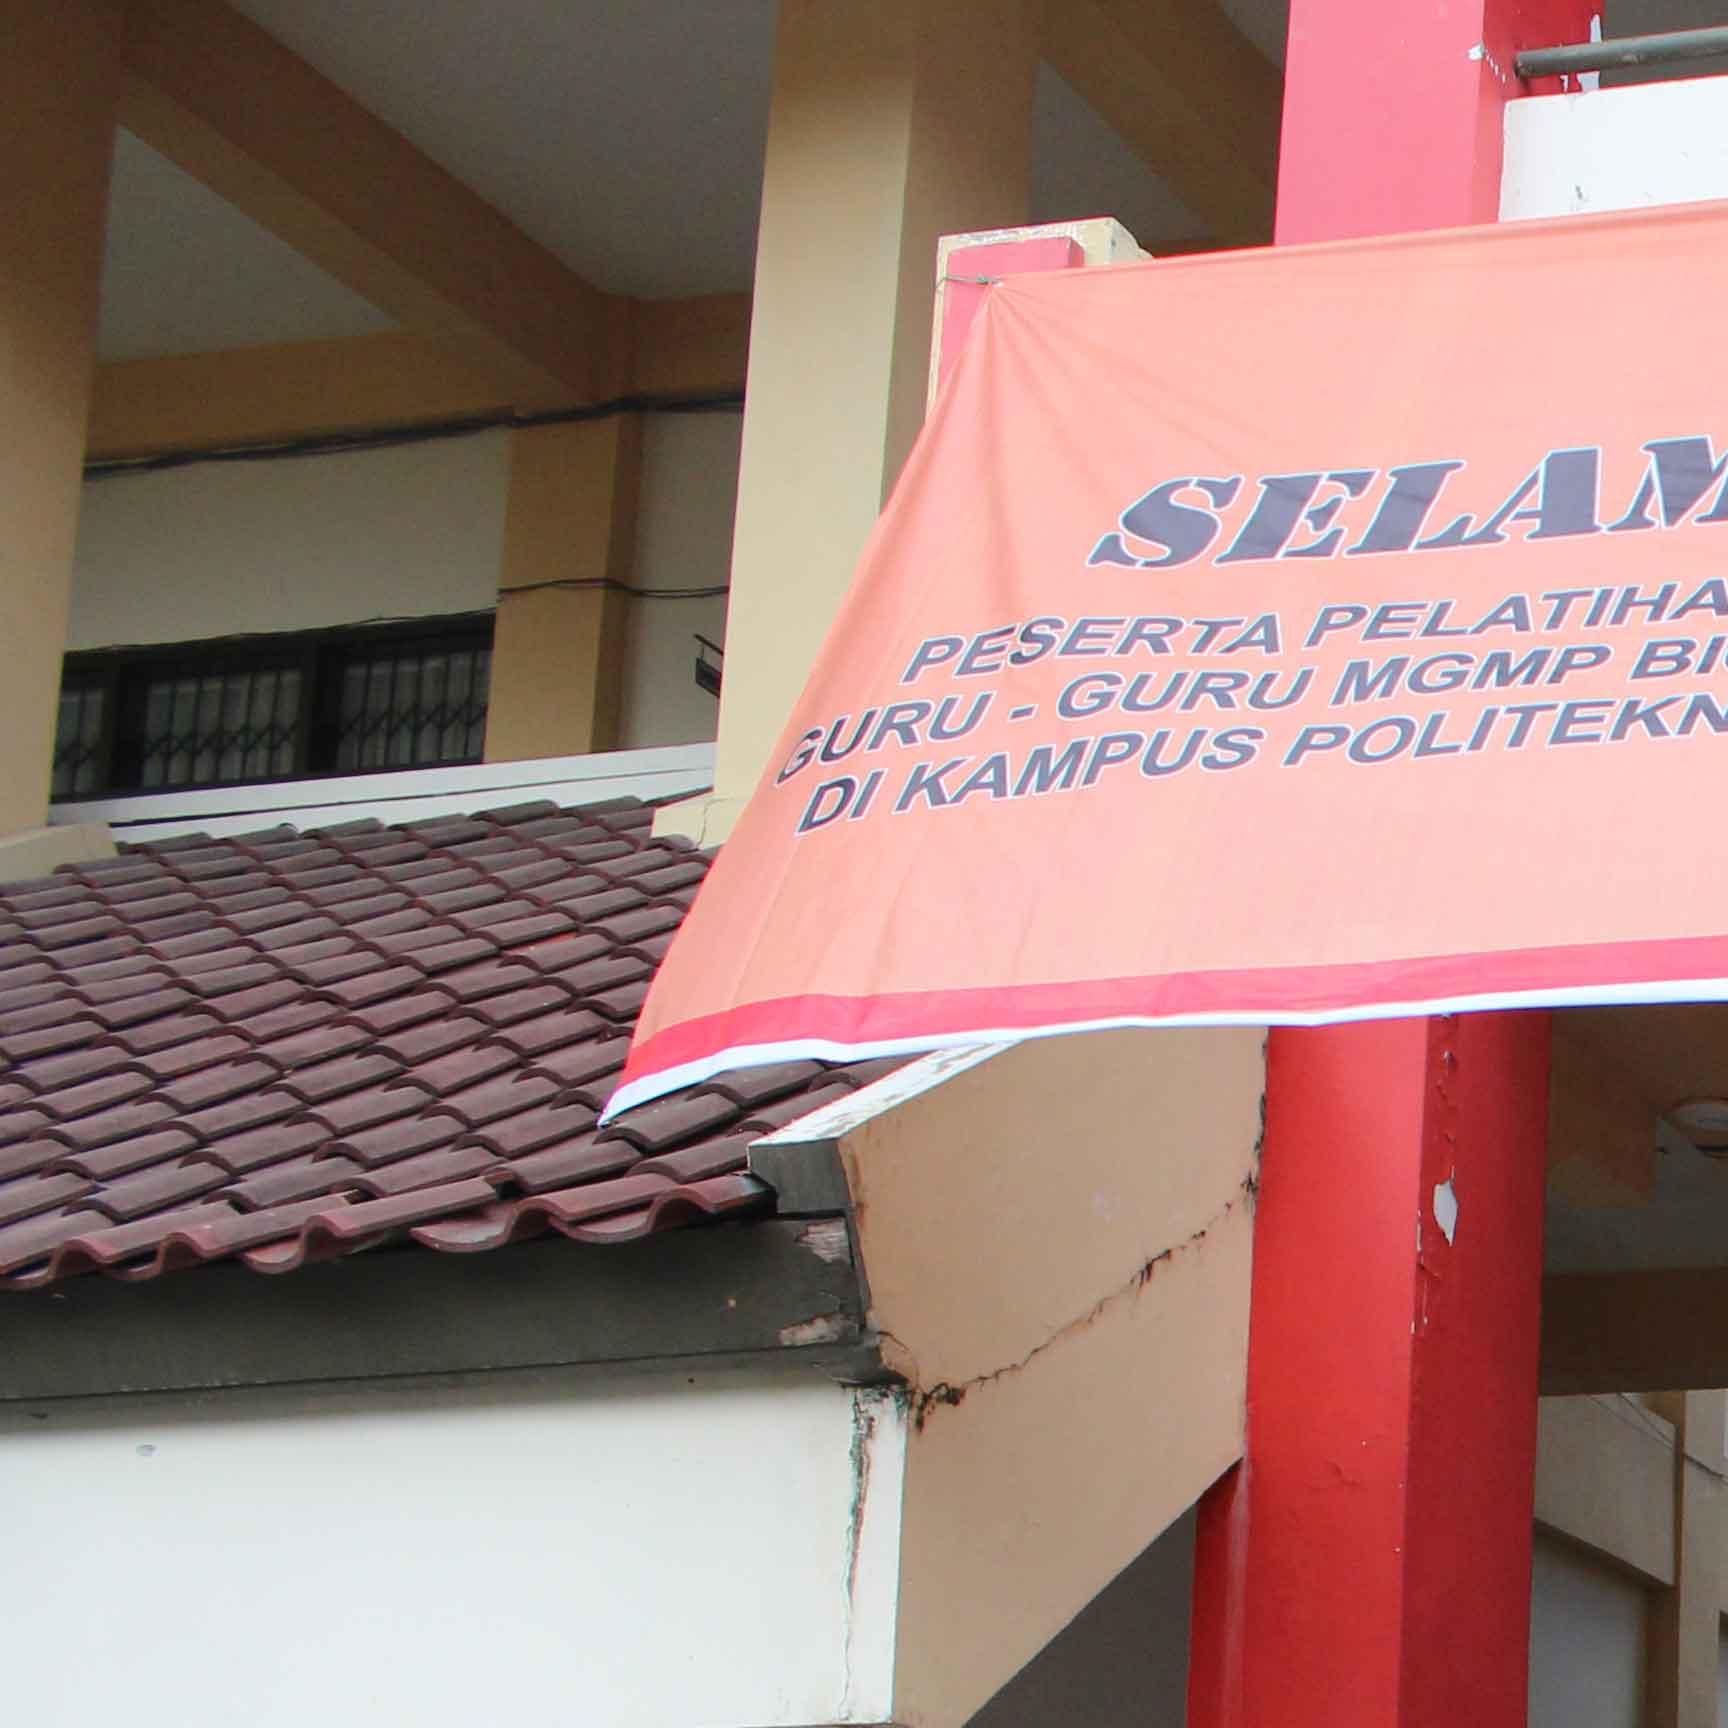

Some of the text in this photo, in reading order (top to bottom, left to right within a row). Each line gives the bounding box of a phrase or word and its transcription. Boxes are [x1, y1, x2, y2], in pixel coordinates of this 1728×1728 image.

[899, 611, 1283, 684] PESERTA
[773, 690, 998, 788] GURU
[1055, 664, 1317, 722] GURU
[1327, 641, 1613, 709] MGMP
[794, 766, 889, 837] DI
[892, 724, 1269, 815] KAMPUS
